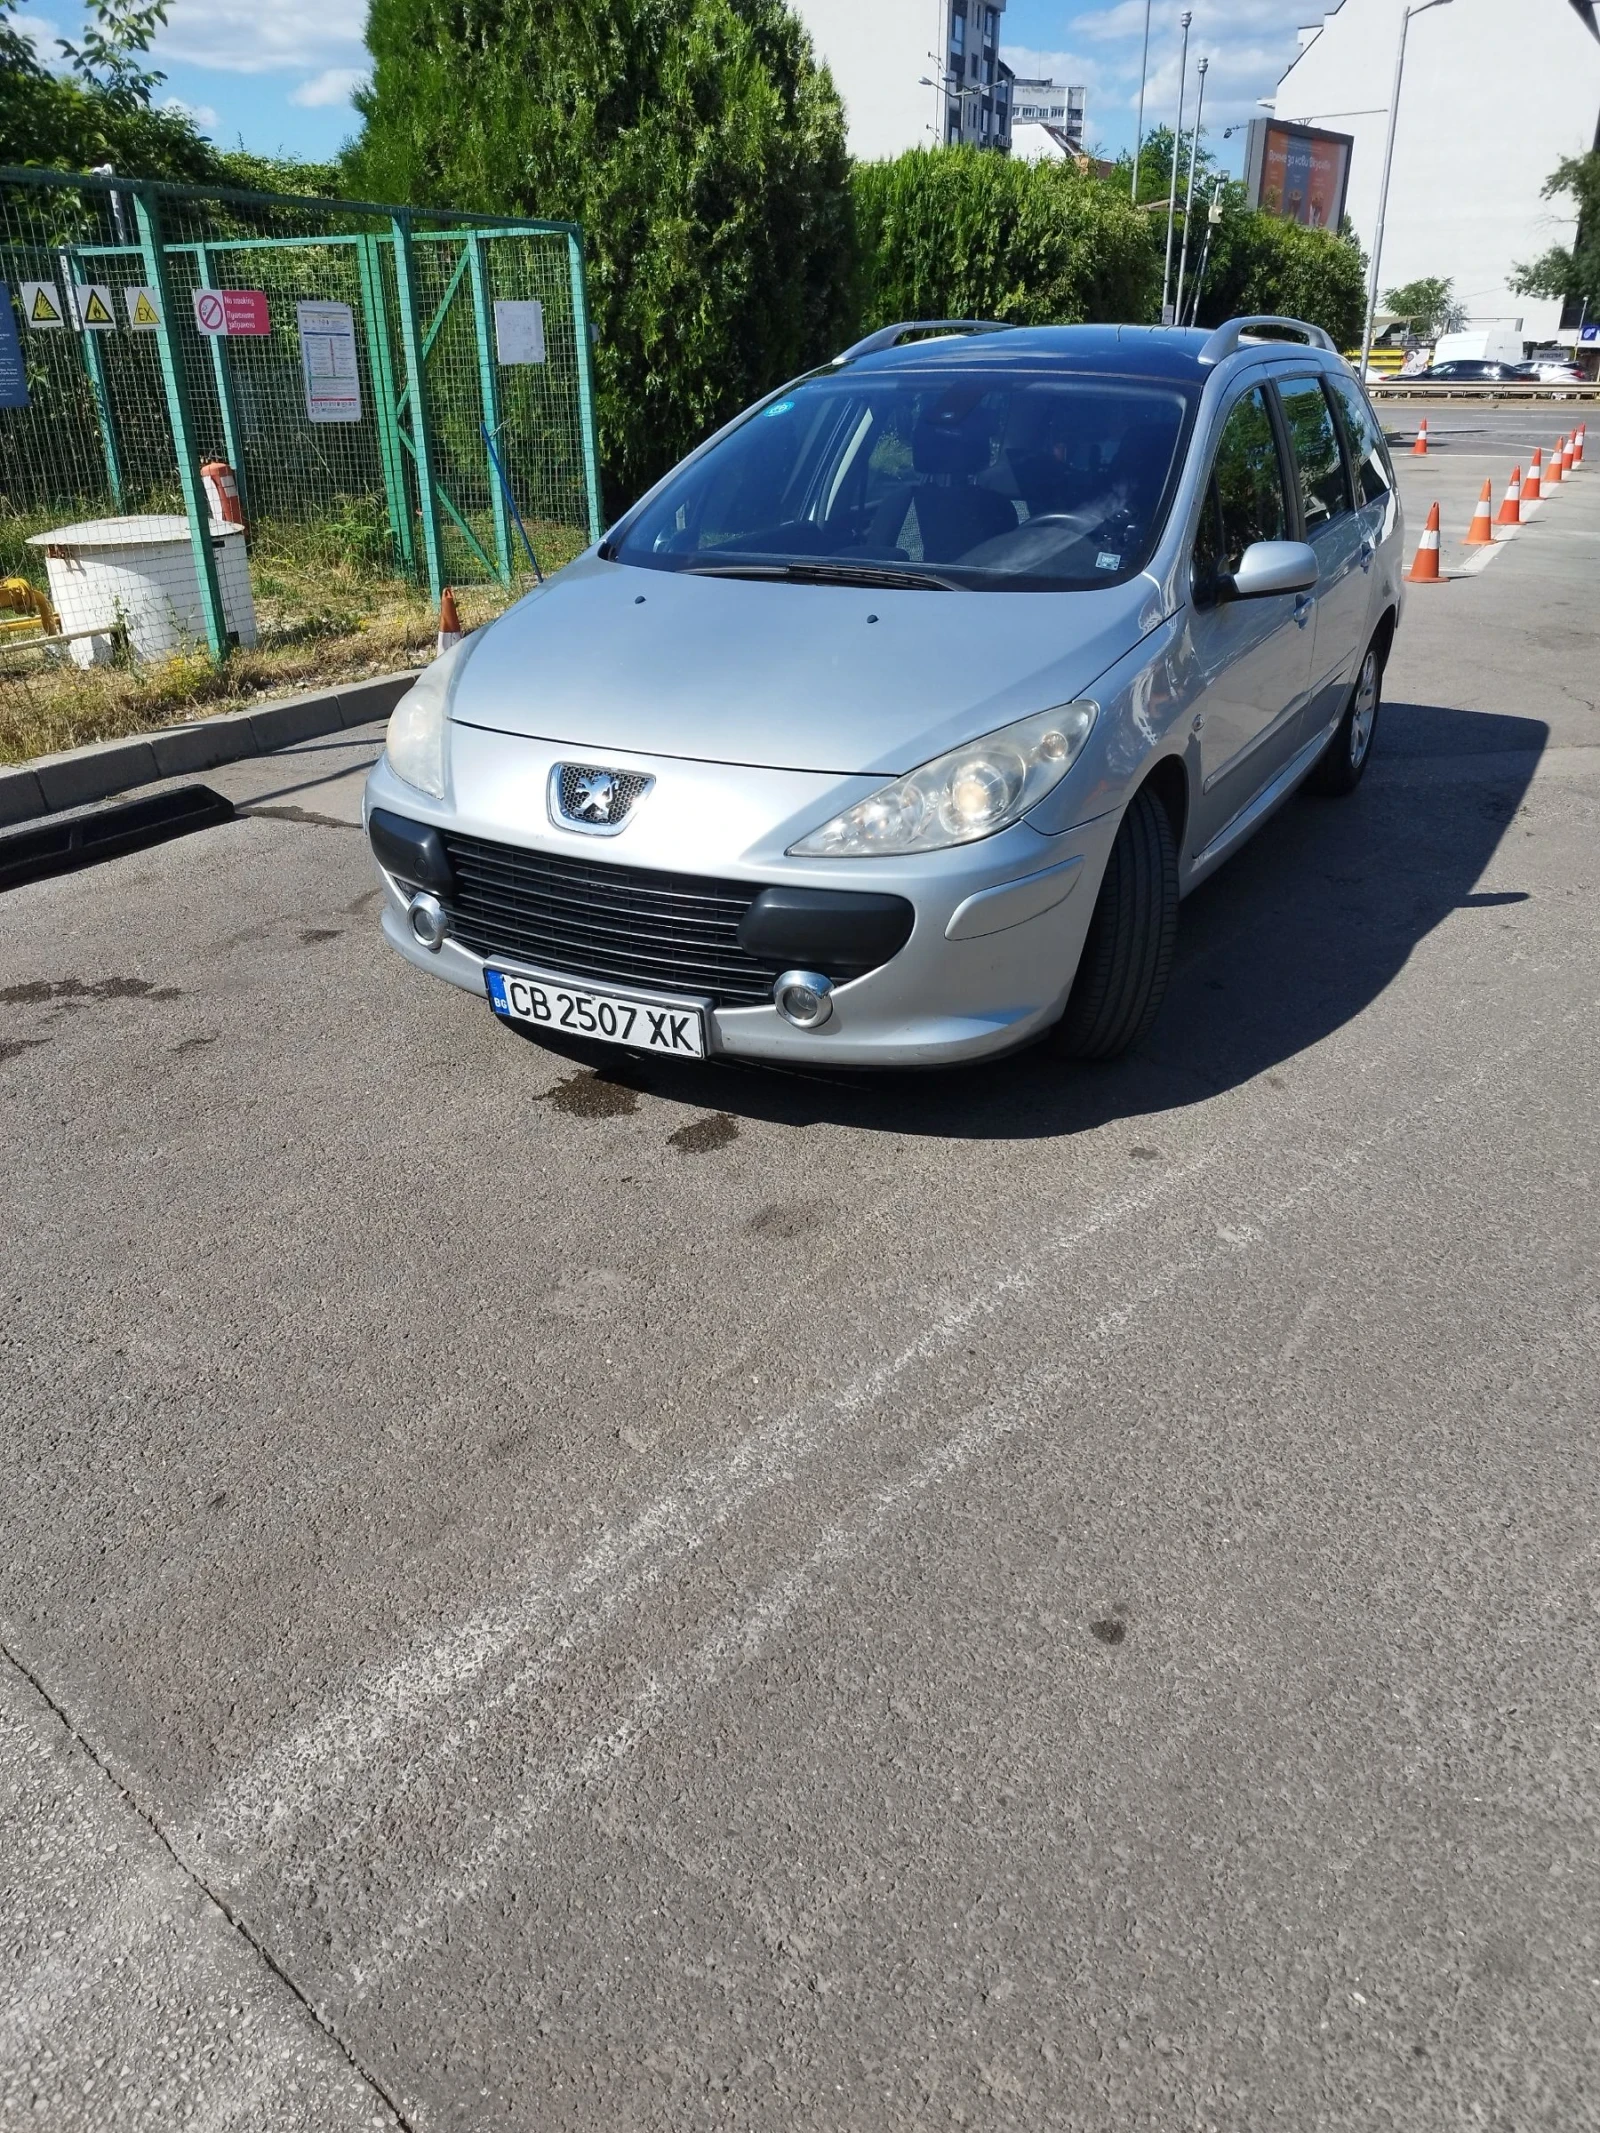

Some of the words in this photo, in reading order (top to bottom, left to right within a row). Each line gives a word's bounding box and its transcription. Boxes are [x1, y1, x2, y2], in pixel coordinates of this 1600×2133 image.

[223, 296, 232, 305] No
[232, 296, 254, 307] smoking
[137, 307, 153, 321] EX
[493, 996, 508, 1009] BG
[556, 993, 637, 1040] 2507
